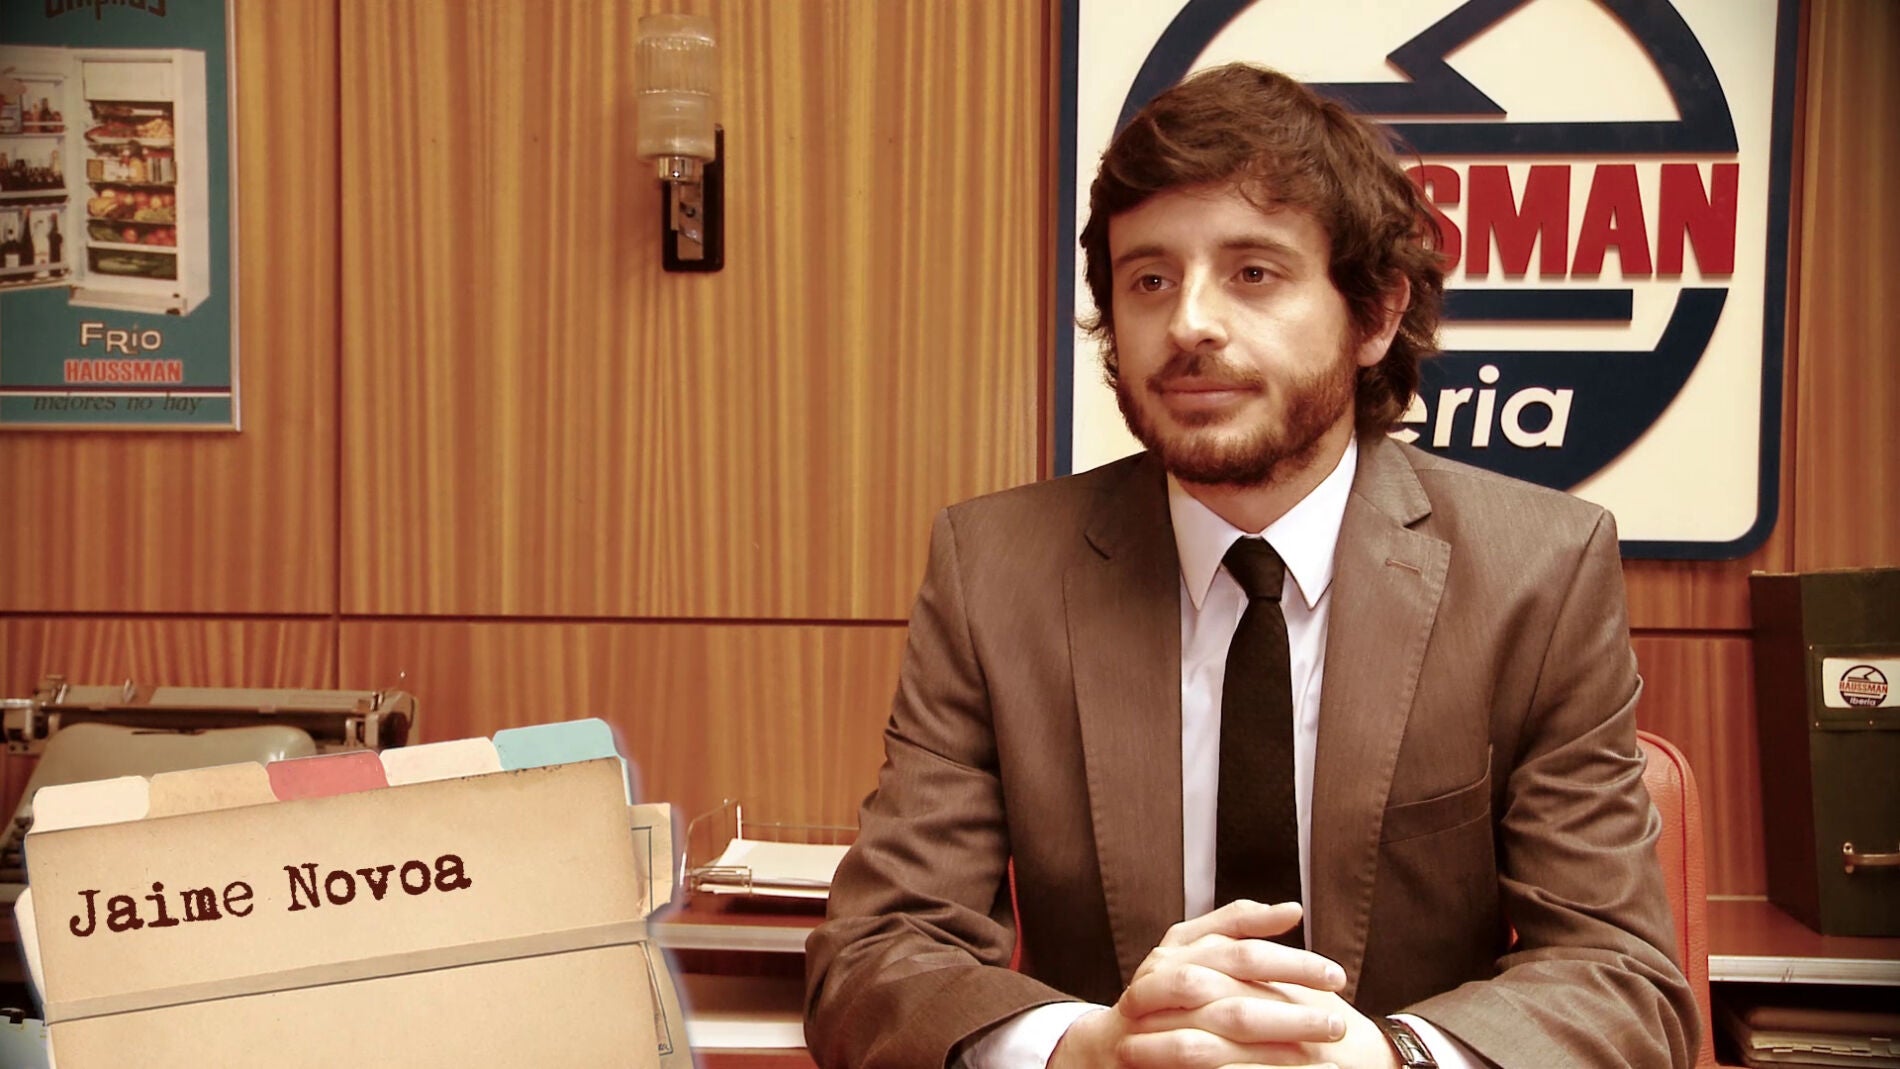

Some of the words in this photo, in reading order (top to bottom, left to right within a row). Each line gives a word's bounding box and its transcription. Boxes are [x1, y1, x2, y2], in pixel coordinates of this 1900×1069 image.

[1404, 163, 1740, 275] SMAN
[64, 359, 183, 383] HAUSSMAN
[126, 396, 153, 411] no
[1387, 364, 1574, 448] eria
[1839, 681, 1888, 694] HAUSSMAN
